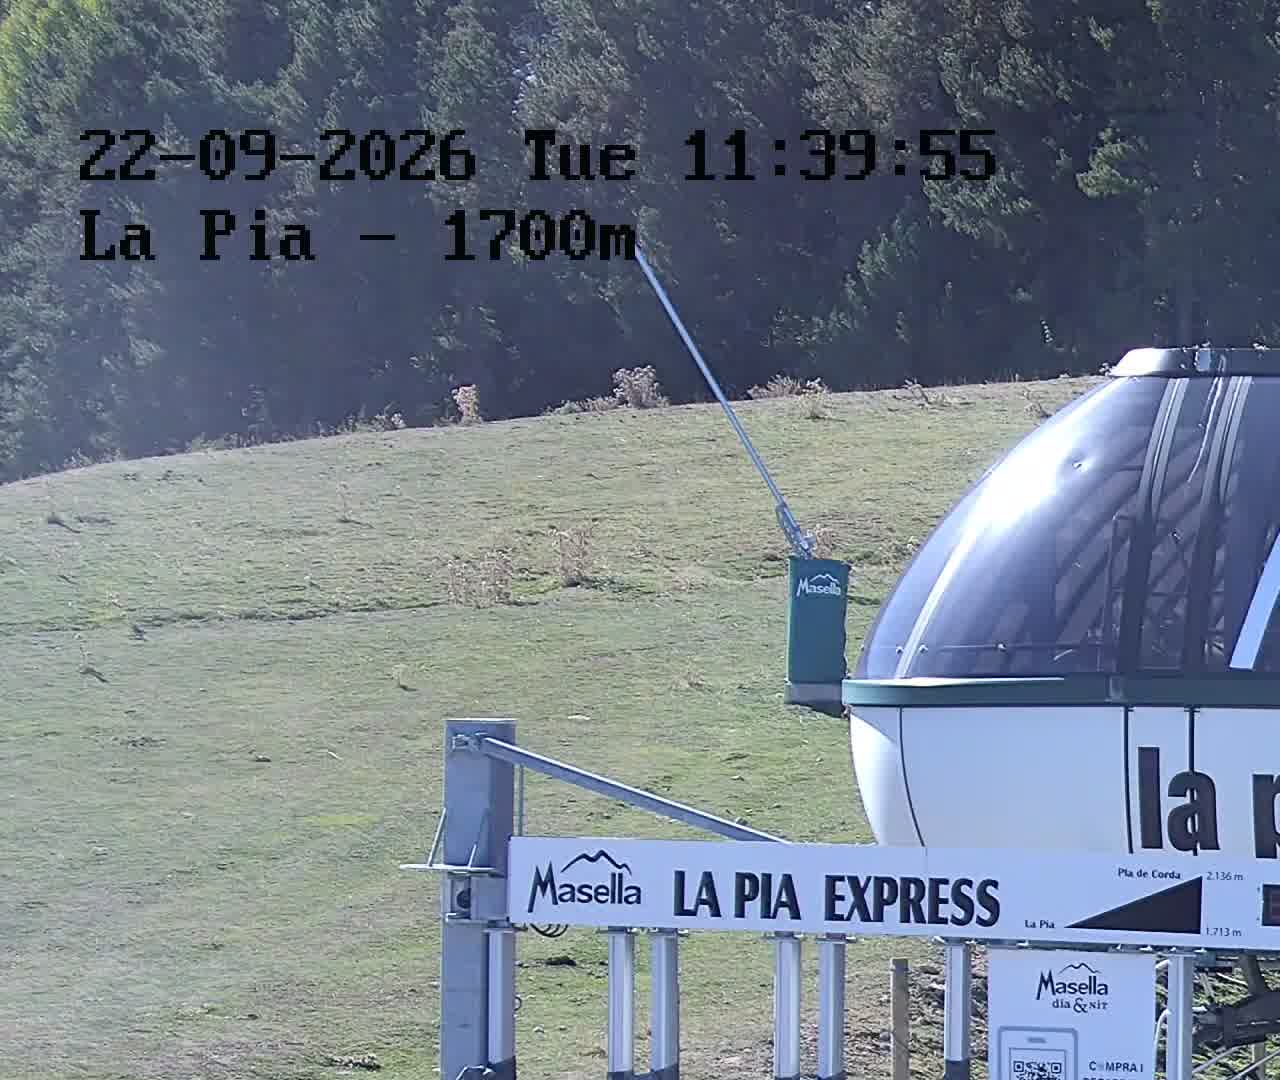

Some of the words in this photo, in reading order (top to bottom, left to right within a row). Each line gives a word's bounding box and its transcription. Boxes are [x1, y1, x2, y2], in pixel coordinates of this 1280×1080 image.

[796, 577, 841, 596] Masella
[1137, 746, 1220, 855] la
[1118, 867, 1133, 878] Pla
[1137, 868, 1148, 878] de
[1151, 869, 1181, 880] Corda
[1207, 871, 1232, 881] 2.136
[1234, 873, 1243, 881] m
[528, 860, 642, 914] Masella
[674, 870, 722, 917] LA
[734, 872, 802, 920] PIA
[824, 874, 1001, 928] EXPRESS
[1025, 919, 1036, 929] La
[1039, 919, 1055, 929] Pia
[1206, 927, 1230, 937] 1.713
[1232, 929, 1242, 937] m
[1036, 969, 1109, 1000] Masella
[1073, 997, 1088, 1013] &
[1088, 1060, 1138, 1073] CMPRA
